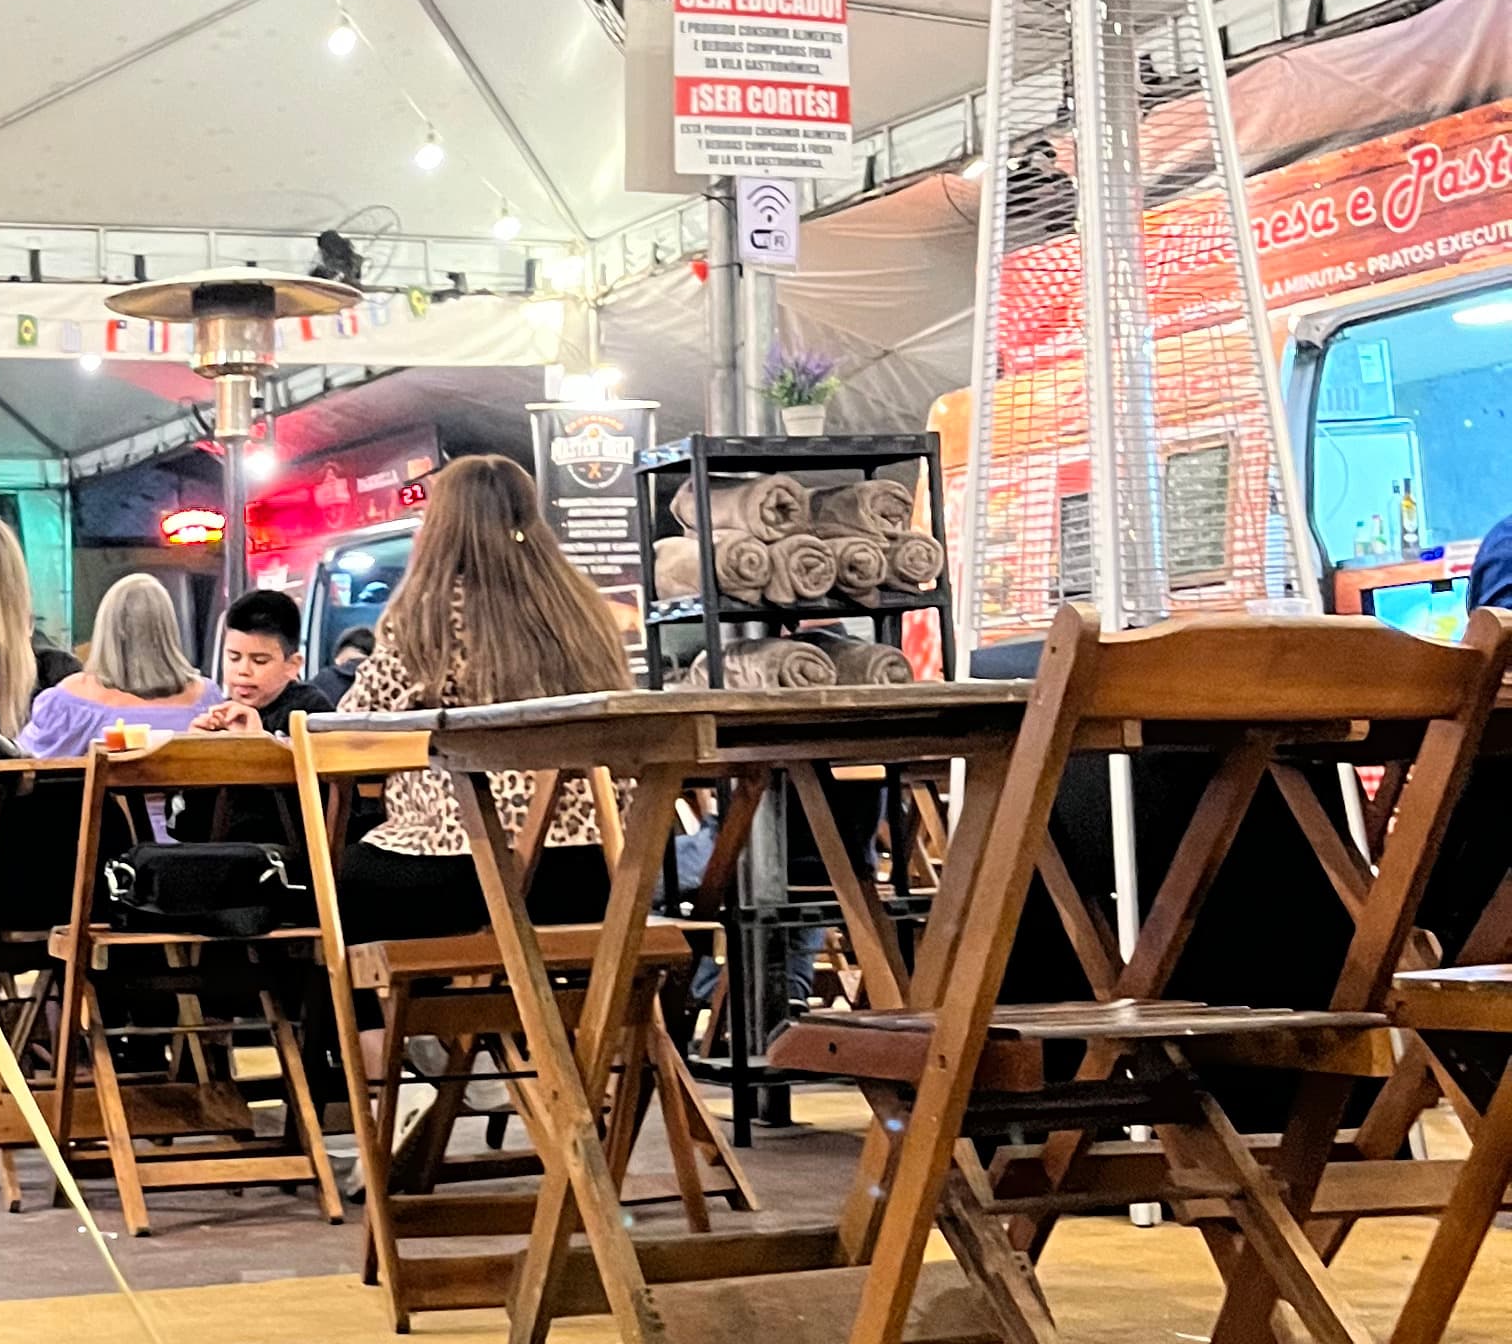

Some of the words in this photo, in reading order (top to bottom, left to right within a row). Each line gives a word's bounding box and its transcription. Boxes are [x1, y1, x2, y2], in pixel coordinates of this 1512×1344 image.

[746, 85, 837, 119] CORTÉS!
[1347, 186, 1376, 226] e
[1367, 241, 1436, 277] PRATOS
